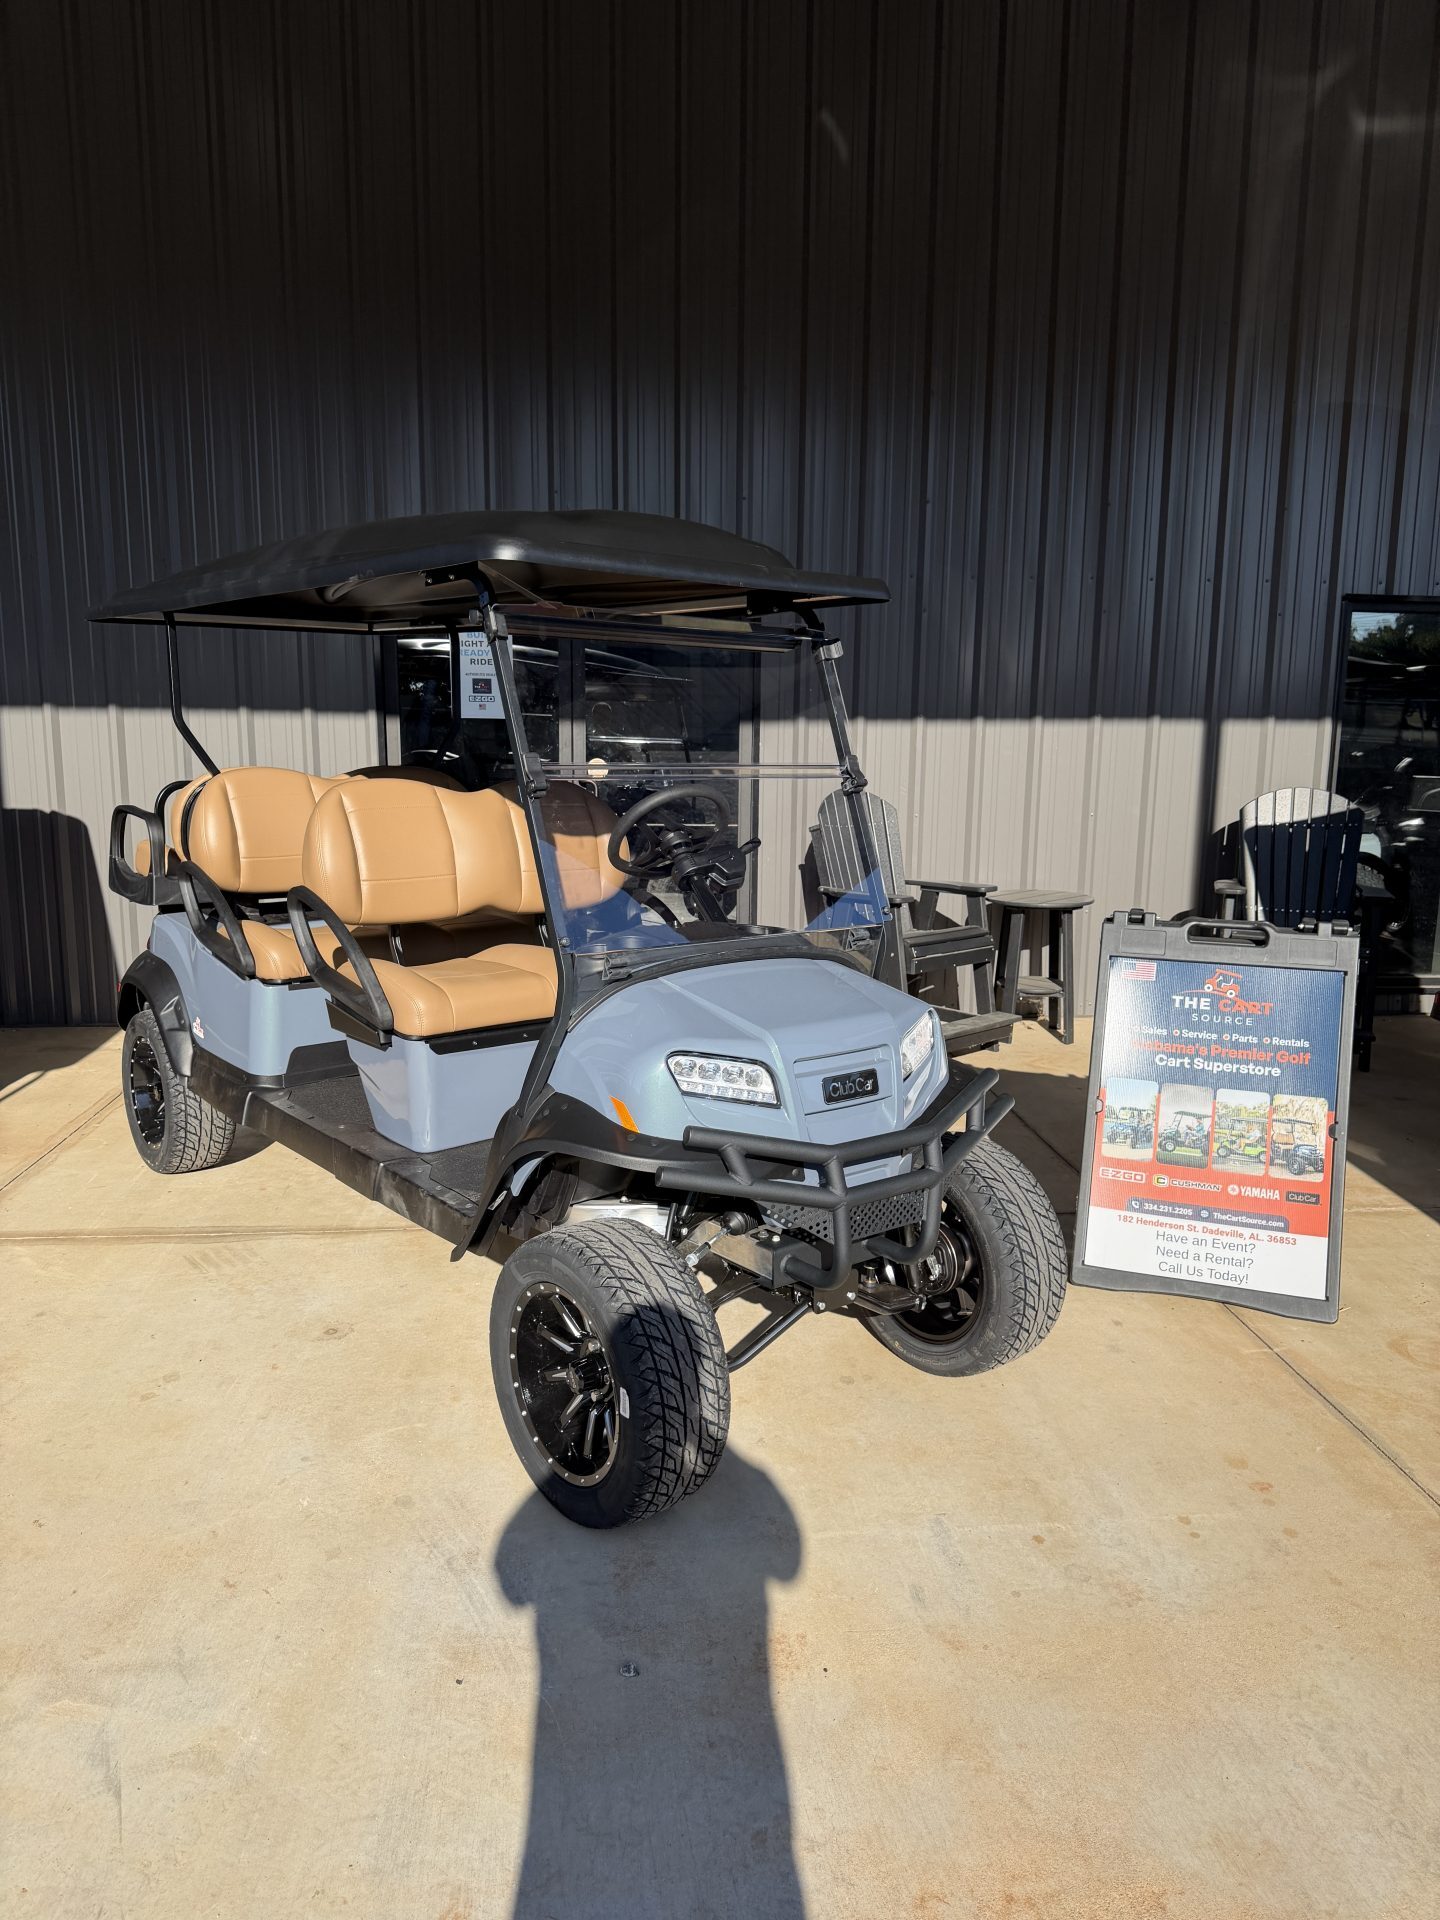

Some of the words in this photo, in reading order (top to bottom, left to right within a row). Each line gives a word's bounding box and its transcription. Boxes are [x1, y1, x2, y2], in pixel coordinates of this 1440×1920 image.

[1172, 995, 1210, 1010] THE
[1218, 999, 1273, 1016] CART
[1192, 1013, 1254, 1026] SOURCE
[1142, 1025, 1168, 1036] Sales
[1182, 1029, 1218, 1040] Service
[1232, 1034, 1258, 1044] Parts
[1272, 1037, 1310, 1048] Rentals
[1131, 1040, 1206, 1056] abama's
[1210, 1045, 1272, 1062] Premier
[1276, 1050, 1311, 1065] Golf
[1155, 1054, 1190, 1068] Cart
[1194, 1058, 1282, 1076] Superstore
[830, 1080, 855, 1097] Club
[856, 1078, 874, 1092] Car
[1171, 1179, 1220, 1191] CUSHMAN
[1240, 1186, 1280, 1200] YAMAHA
[1144, 1202, 1193, 1216] 334.231.2205
[1213, 1212, 1284, 1228] TheCartSource.com
[1117, 1214, 1134, 1223] 182
[1136, 1216, 1184, 1231] Henderson
[1187, 1224, 1199, 1233] St.
[1202, 1226, 1246, 1240] Dadeville,
[1248, 1232, 1264, 1242] AL.
[1267, 1235, 1297, 1246] 36853
[1156, 1231, 1188, 1245] Have
[1192, 1237, 1208, 1247] an
[1212, 1238, 1256, 1254] Event?
[1156, 1246, 1189, 1260] Need
[1193, 1253, 1201, 1262] a
[1205, 1253, 1254, 1269] Rental?
[1158, 1261, 1182, 1274] Call
[1186, 1265, 1203, 1277] Us
[1209, 1268, 1249, 1285] Today!
